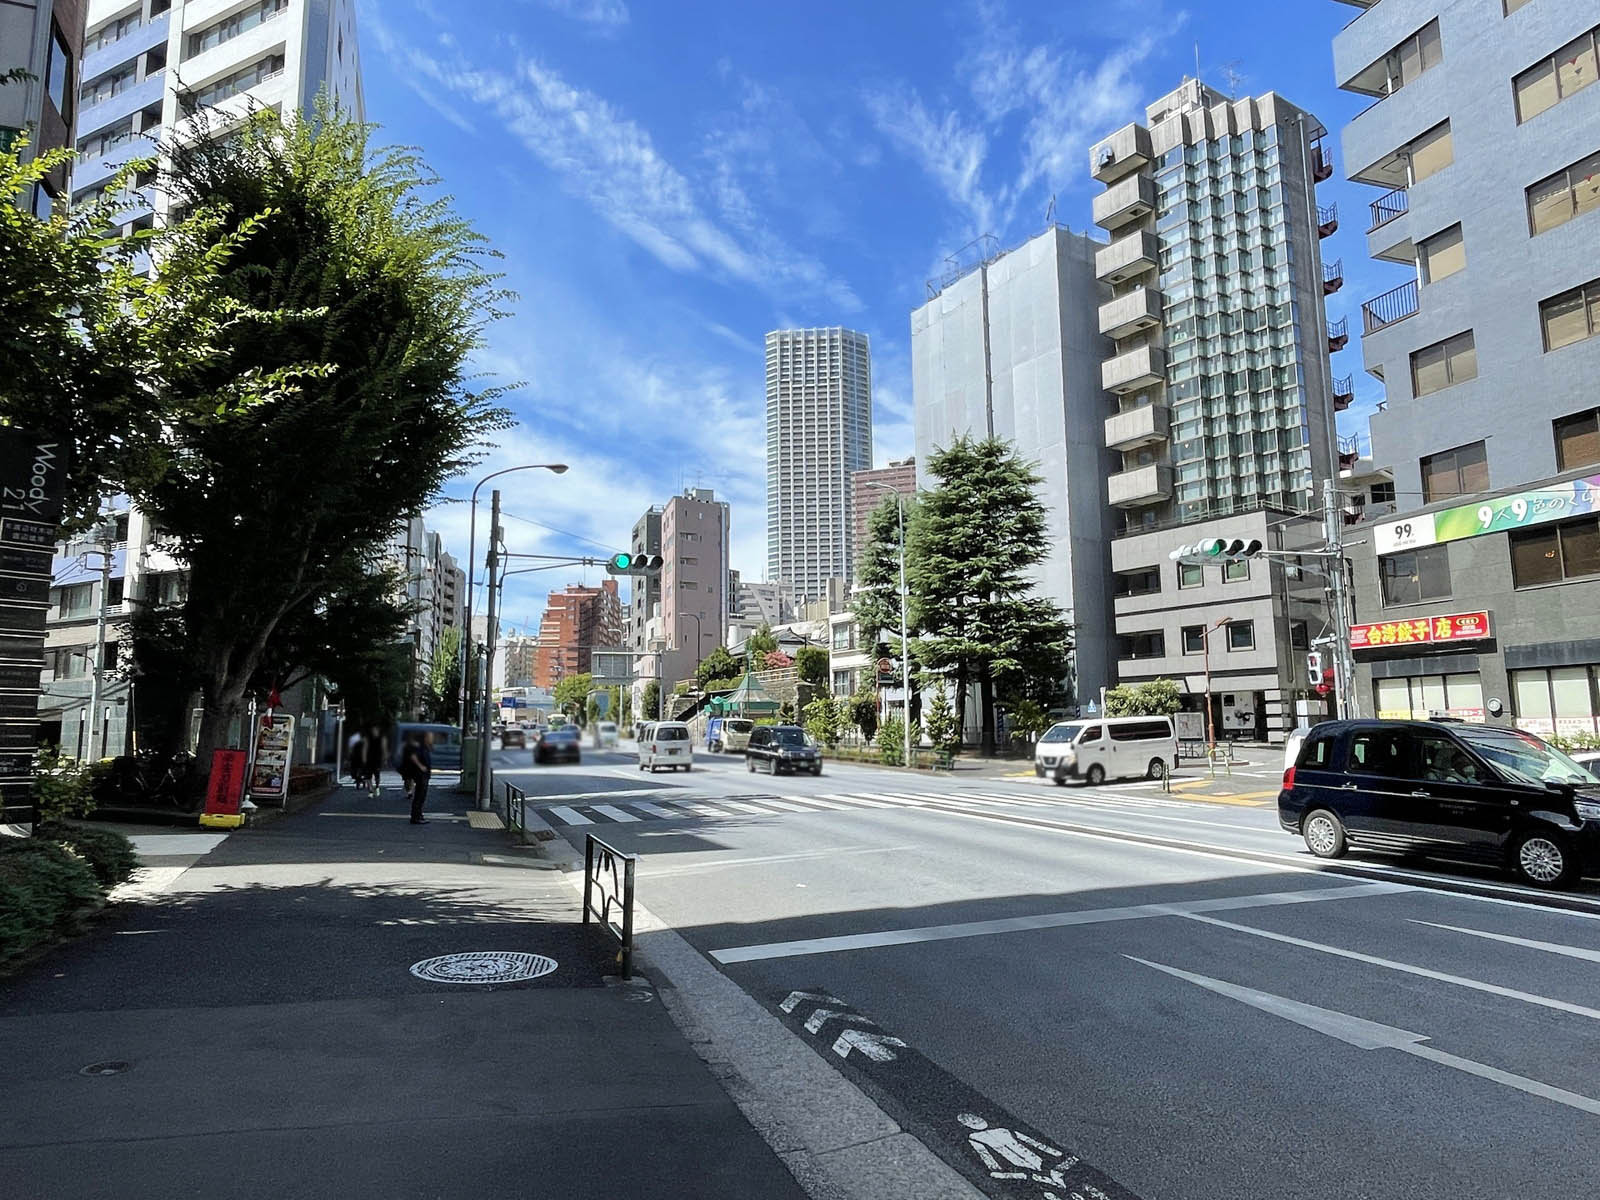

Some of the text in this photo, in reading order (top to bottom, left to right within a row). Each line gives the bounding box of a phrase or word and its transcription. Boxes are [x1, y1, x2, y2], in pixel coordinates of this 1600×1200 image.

[23, 443, 59, 515] Woody
[2, 486, 26, 511] 21
[1394, 523, 1412, 540] 99
[1367, 618, 1452, 645] 台湾餃子店
